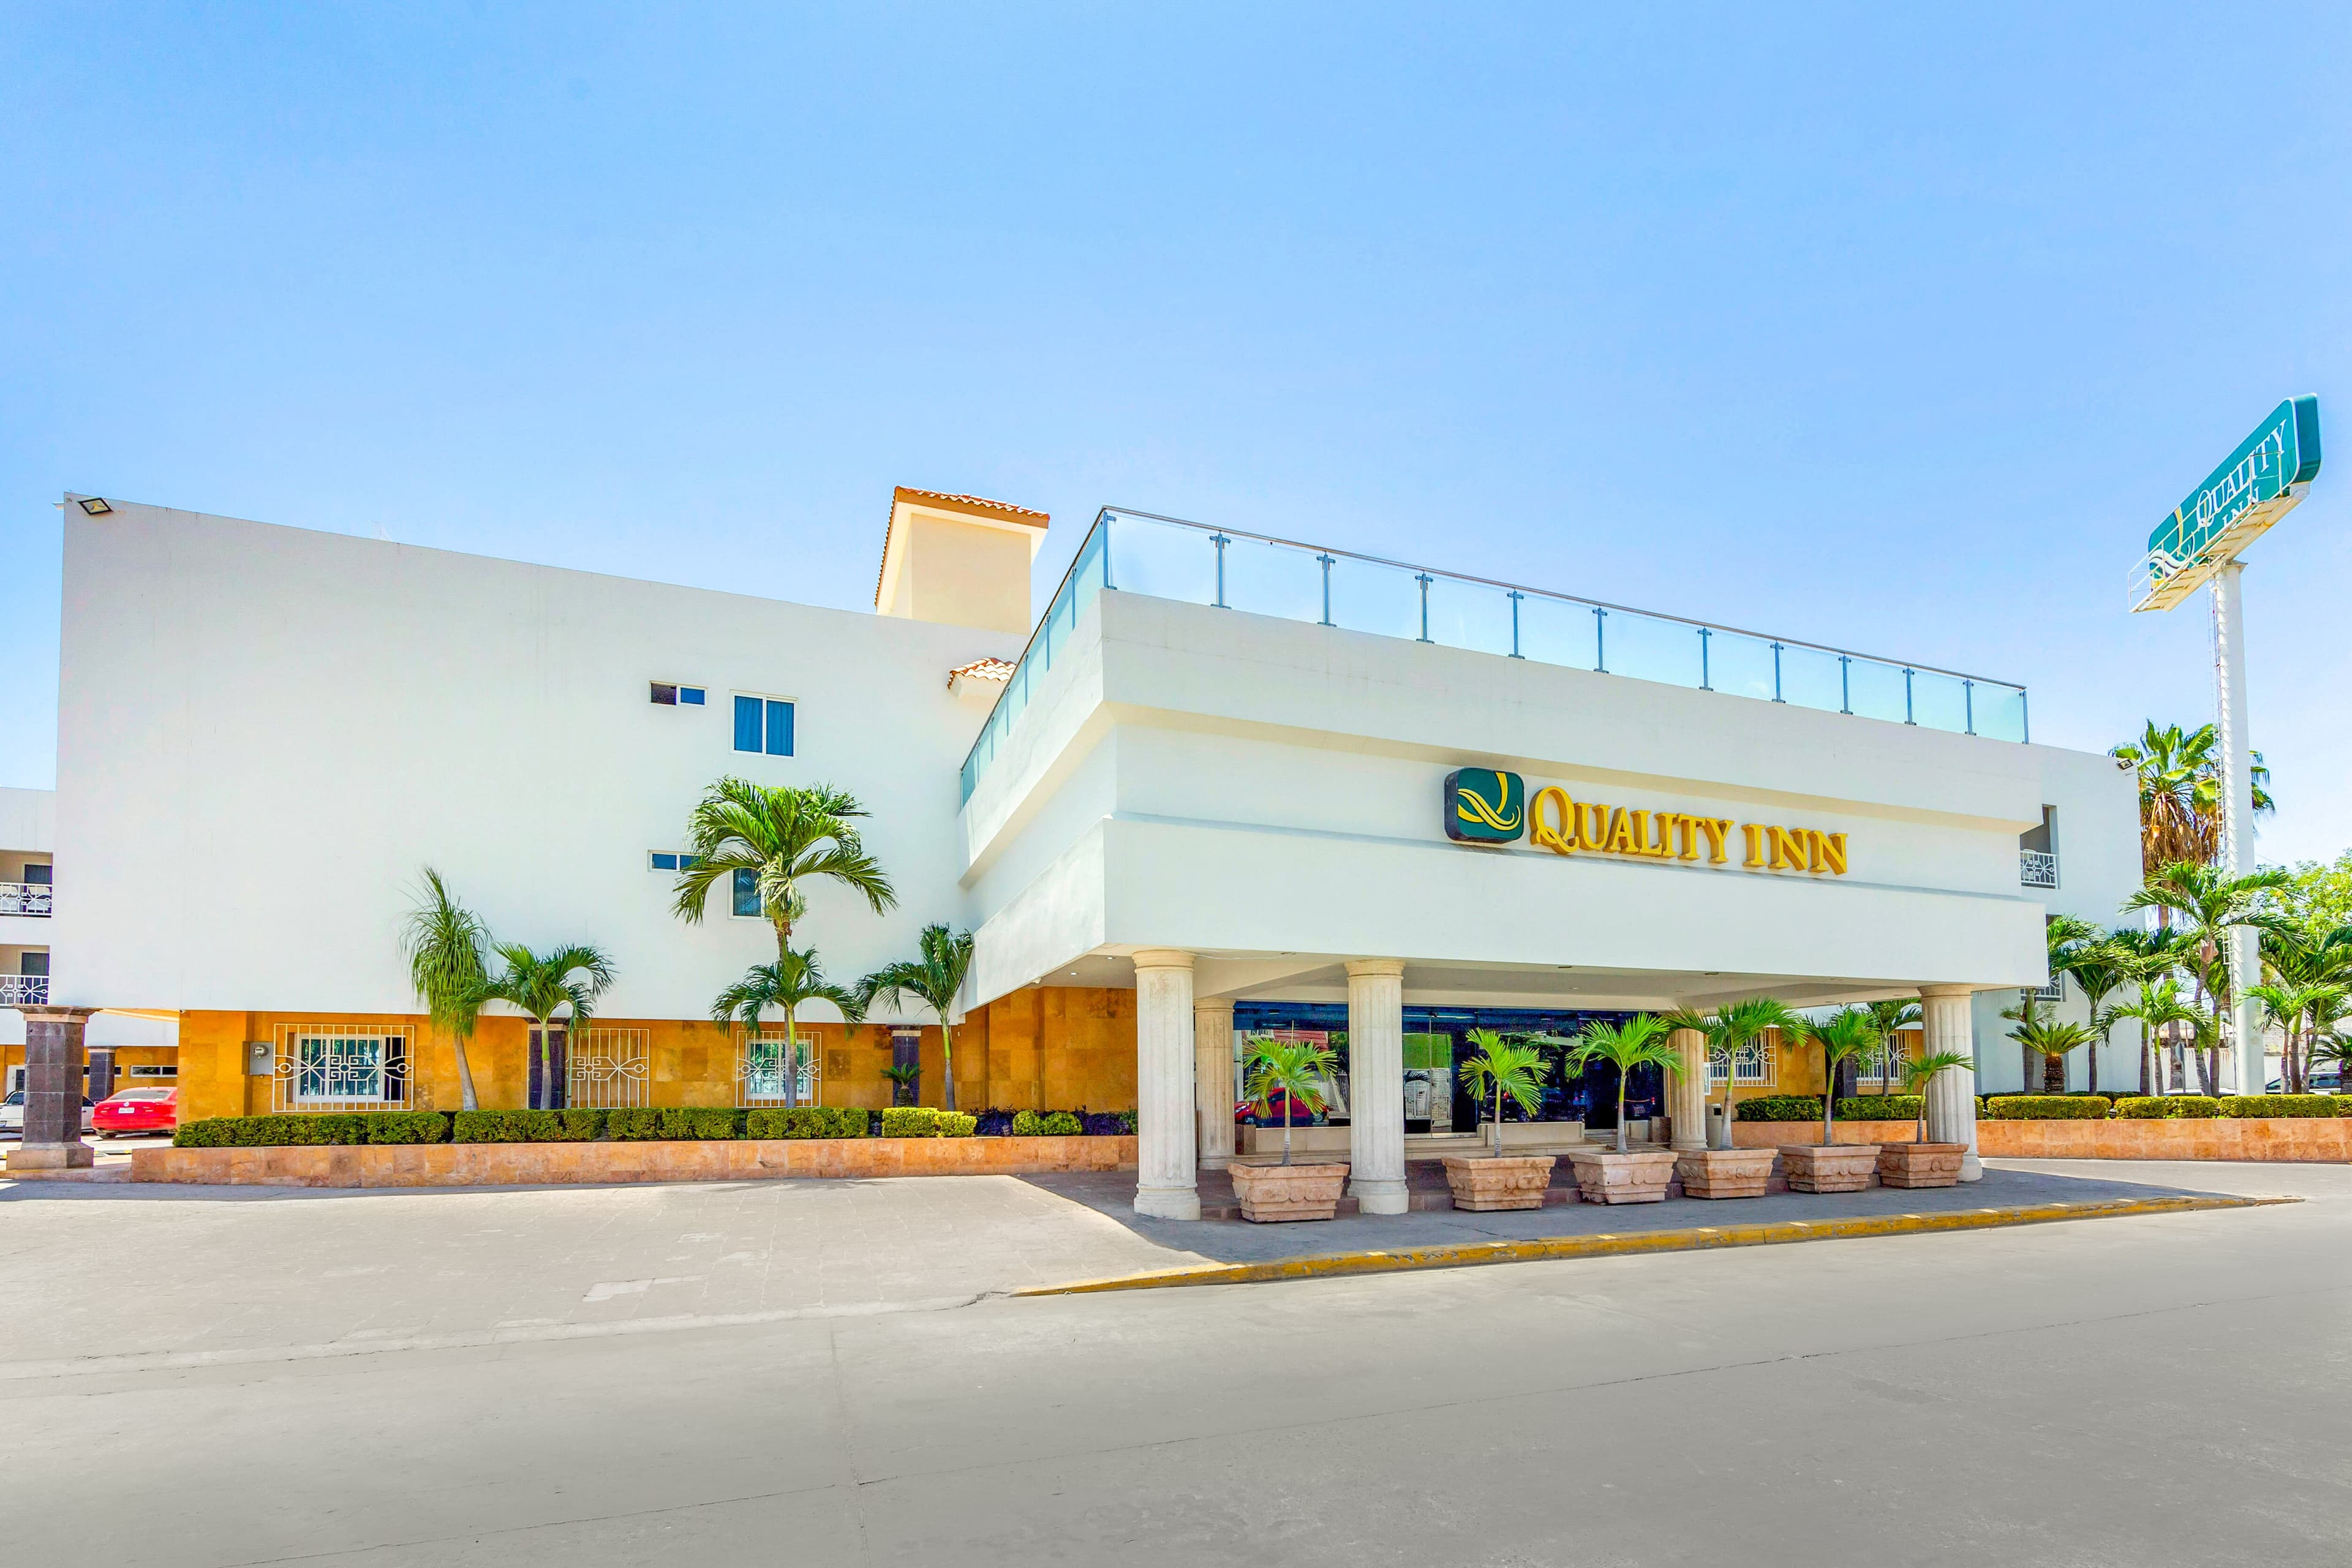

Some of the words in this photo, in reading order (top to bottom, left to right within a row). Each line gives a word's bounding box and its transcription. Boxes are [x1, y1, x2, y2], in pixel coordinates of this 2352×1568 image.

[2196, 419, 2286, 527] QUALITY
[1528, 786, 1735, 863] QUALITY
[1741, 823, 1849, 875] INN
